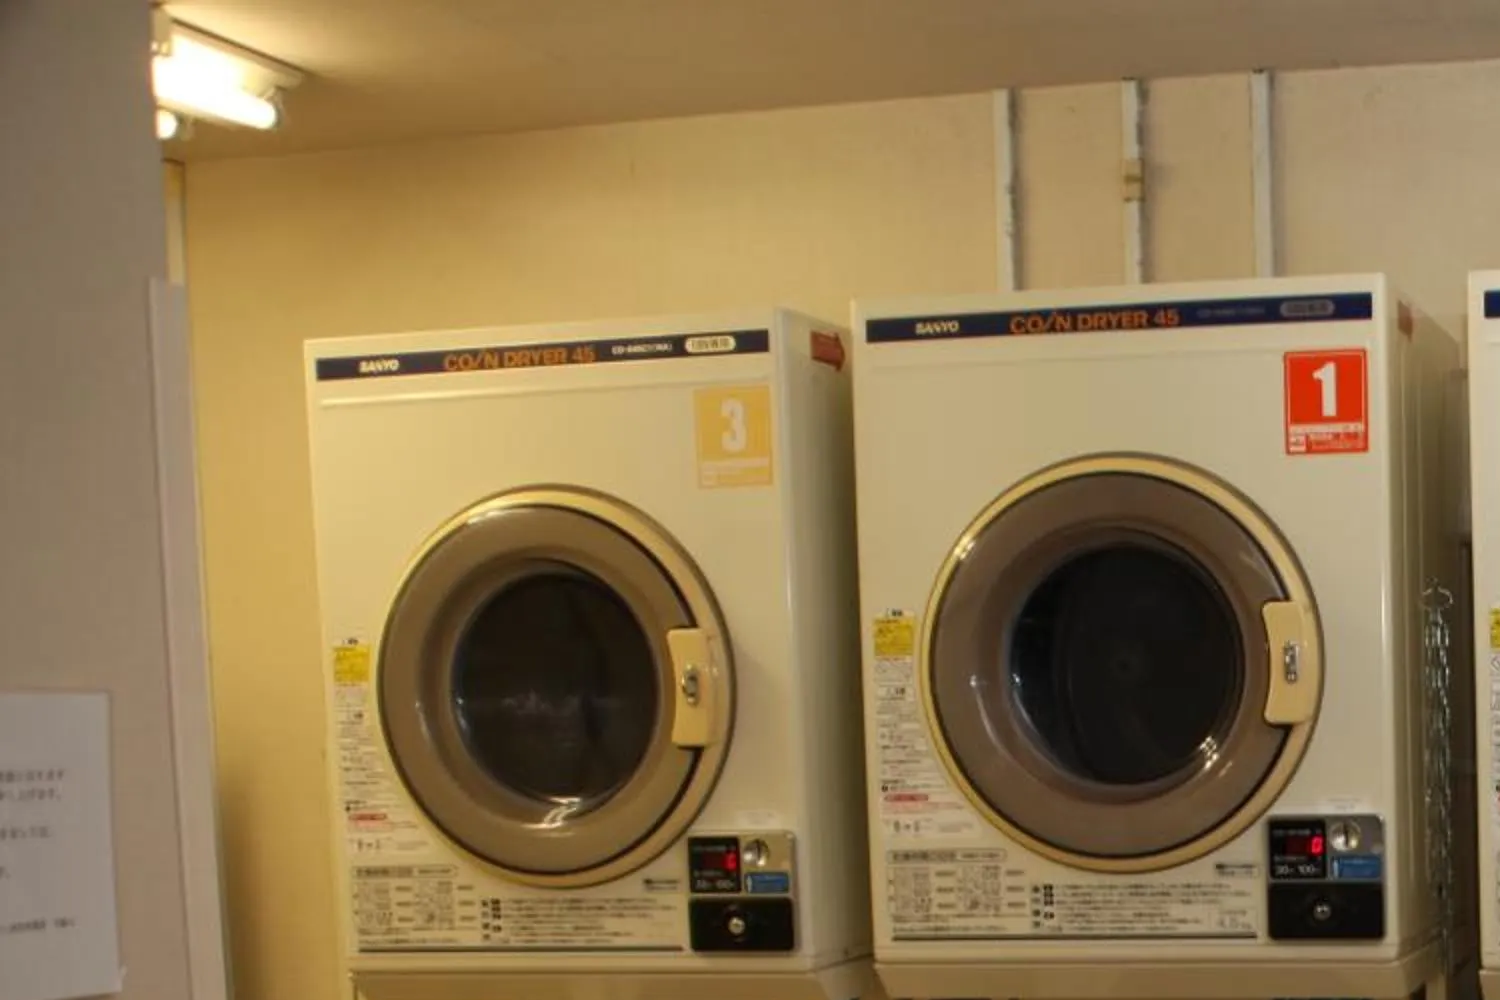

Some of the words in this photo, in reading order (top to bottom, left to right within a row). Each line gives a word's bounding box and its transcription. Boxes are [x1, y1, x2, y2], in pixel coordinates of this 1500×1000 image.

[915, 320, 960, 336] SANYO
[1076, 309, 1149, 331] DRYER
[1153, 307, 1180, 327] 45
[359, 358, 400, 374] SANYO
[503, 347, 567, 369] DRYER
[571, 344, 596, 364] 45
[1312, 361, 1337, 417] 1
[721, 398, 747, 452] 3
